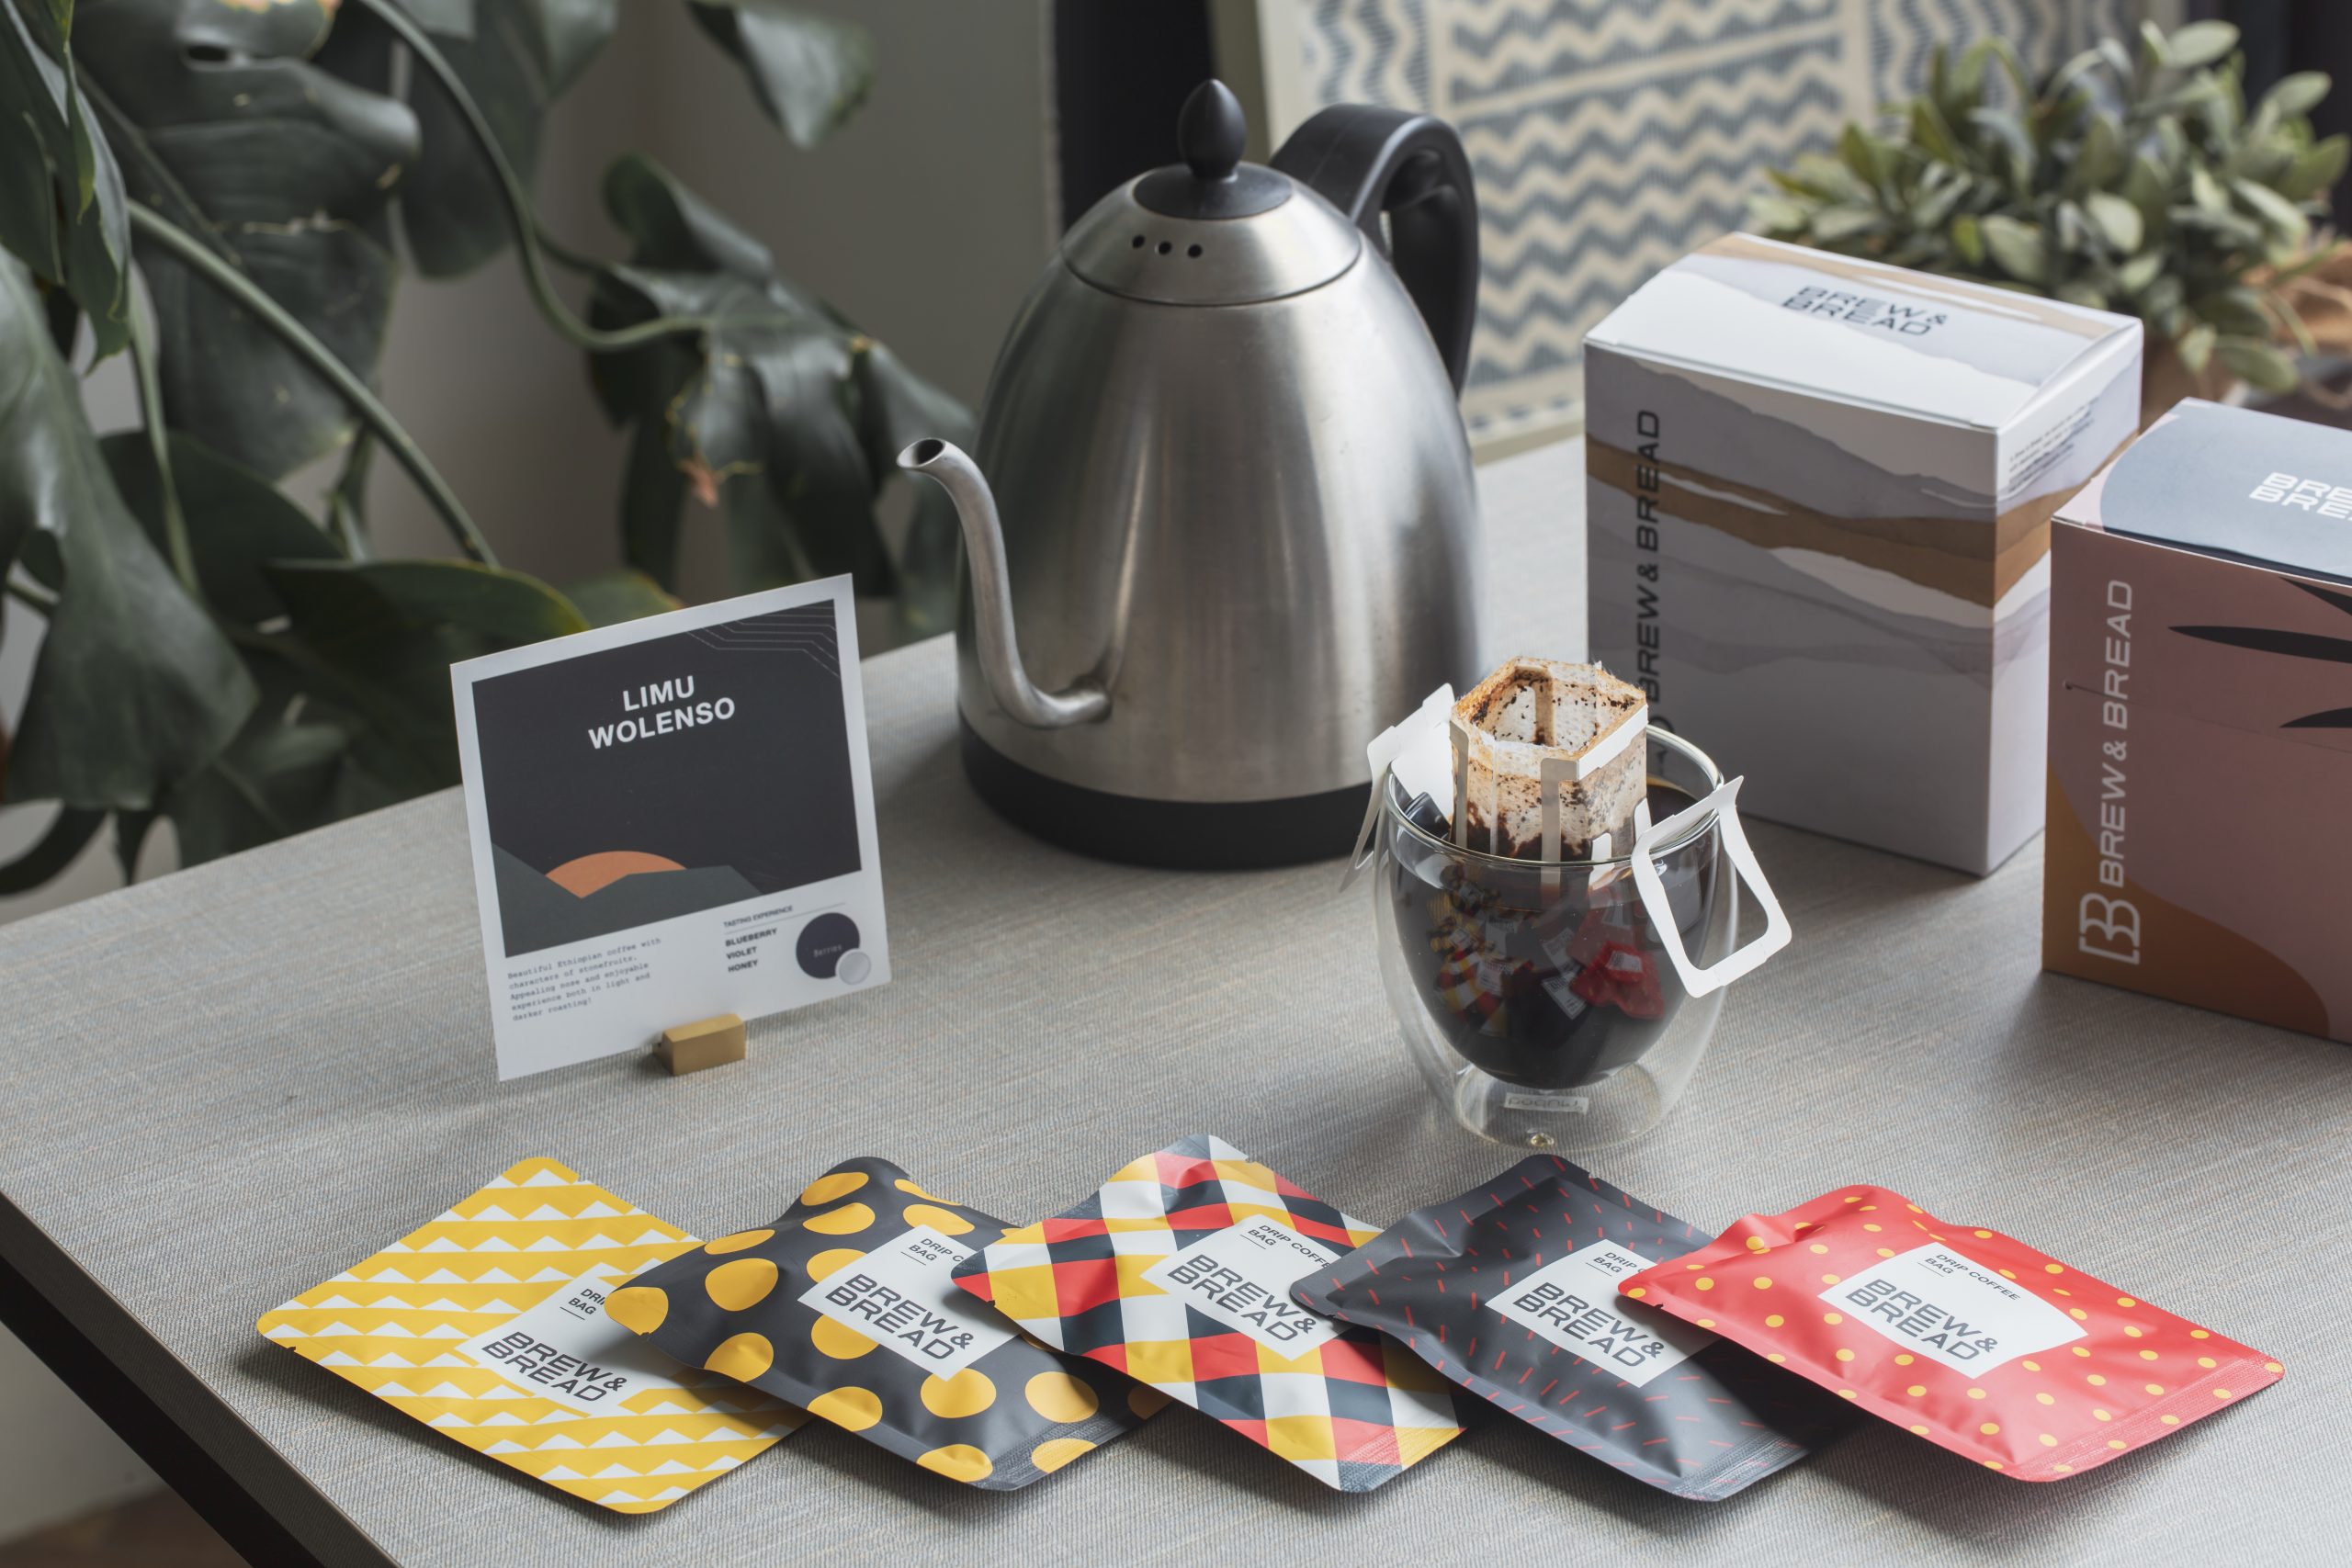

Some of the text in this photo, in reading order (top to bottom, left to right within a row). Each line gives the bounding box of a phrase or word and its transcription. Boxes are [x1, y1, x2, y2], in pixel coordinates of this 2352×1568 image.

[1781, 298, 1932, 335] BREAD
[2248, 485, 2352, 521] BRE
[1636, 410, 1660, 704] BREW & BREAD
[2102, 580, 2132, 729] BREAD
[623, 675, 695, 711] LIMU
[588, 697, 735, 750] WOLENSO
[2103, 740, 2127, 761] &
[2099, 762, 2127, 888] BREW
[723, 905, 793, 928] TASTING EXPERIENCE
[725, 928, 777, 947] BLUEBERRY
[726, 946, 757, 960] VIOLET
[507, 937, 662, 979] Beautiful Ethiopian coffee with
[728, 959, 758, 973] HONEY
[509, 974, 560, 990] characters
[564, 969, 574, 978] of
[510, 963, 650, 1000] Appealing nose and enjoyable
[512, 973, 650, 1011] experience both in light and
[513, 1009, 543, 1021] darker
[909, 1245, 937, 1261] BAG
[921, 1238, 953, 1255] DRIP
[1248, 1229, 1276, 1247] BAG
[1259, 1224, 1330, 1269] DRIP COFFE
[1593, 1257, 1623, 1273] BAG
[1604, 1252, 1637, 1268] DRIP
[1925, 1258, 1954, 1275] BAG
[1936, 1254, 2021, 1301] DRIP COFFEE
[569, 1297, 596, 1314] BAG
[1167, 1265, 1298, 1340] BREAD
[825, 1285, 955, 1359] BREAD
[1512, 1293, 1646, 1367] BREAD
[1845, 1288, 1980, 1359] BREAD
[481, 1341, 607, 1402] BREAD
